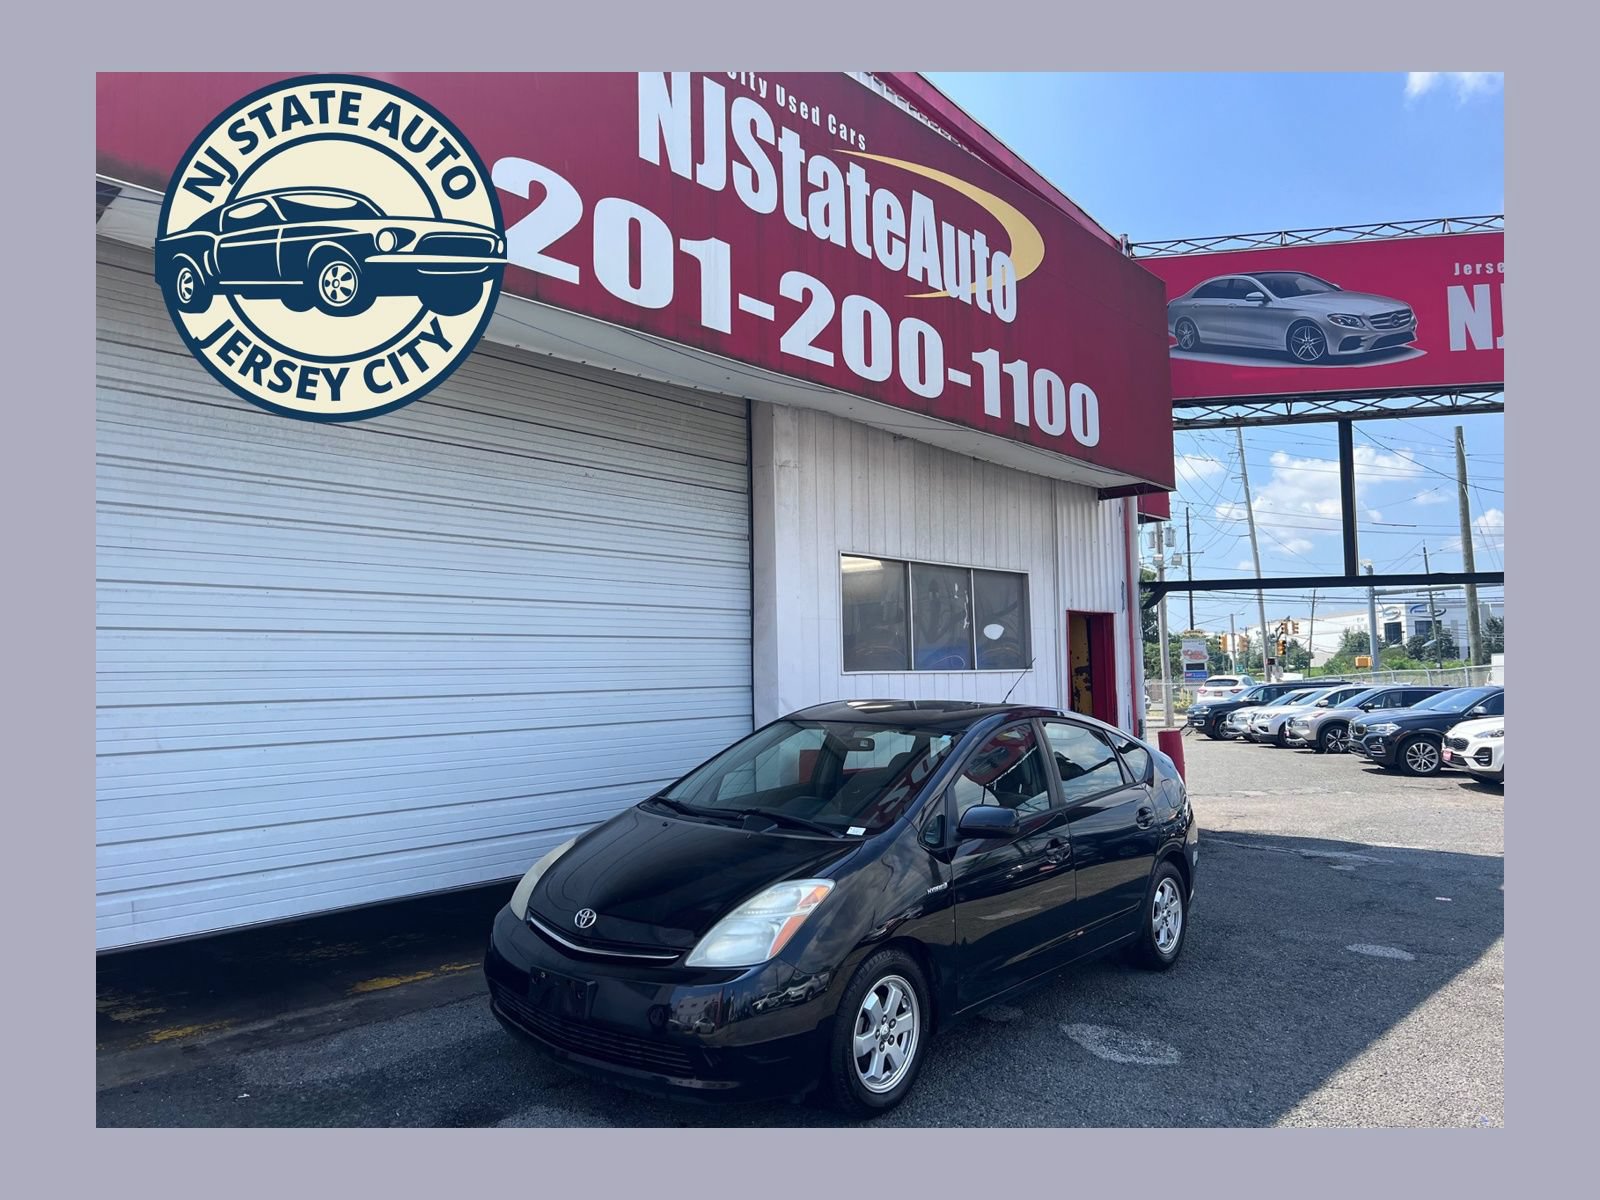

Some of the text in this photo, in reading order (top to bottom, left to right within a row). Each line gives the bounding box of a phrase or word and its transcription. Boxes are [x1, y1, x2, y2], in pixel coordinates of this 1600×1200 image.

[776, 84, 820, 127] Used
[827, 114, 866, 151] Cars
[491, 157, 1100, 447] 201-200-1100
